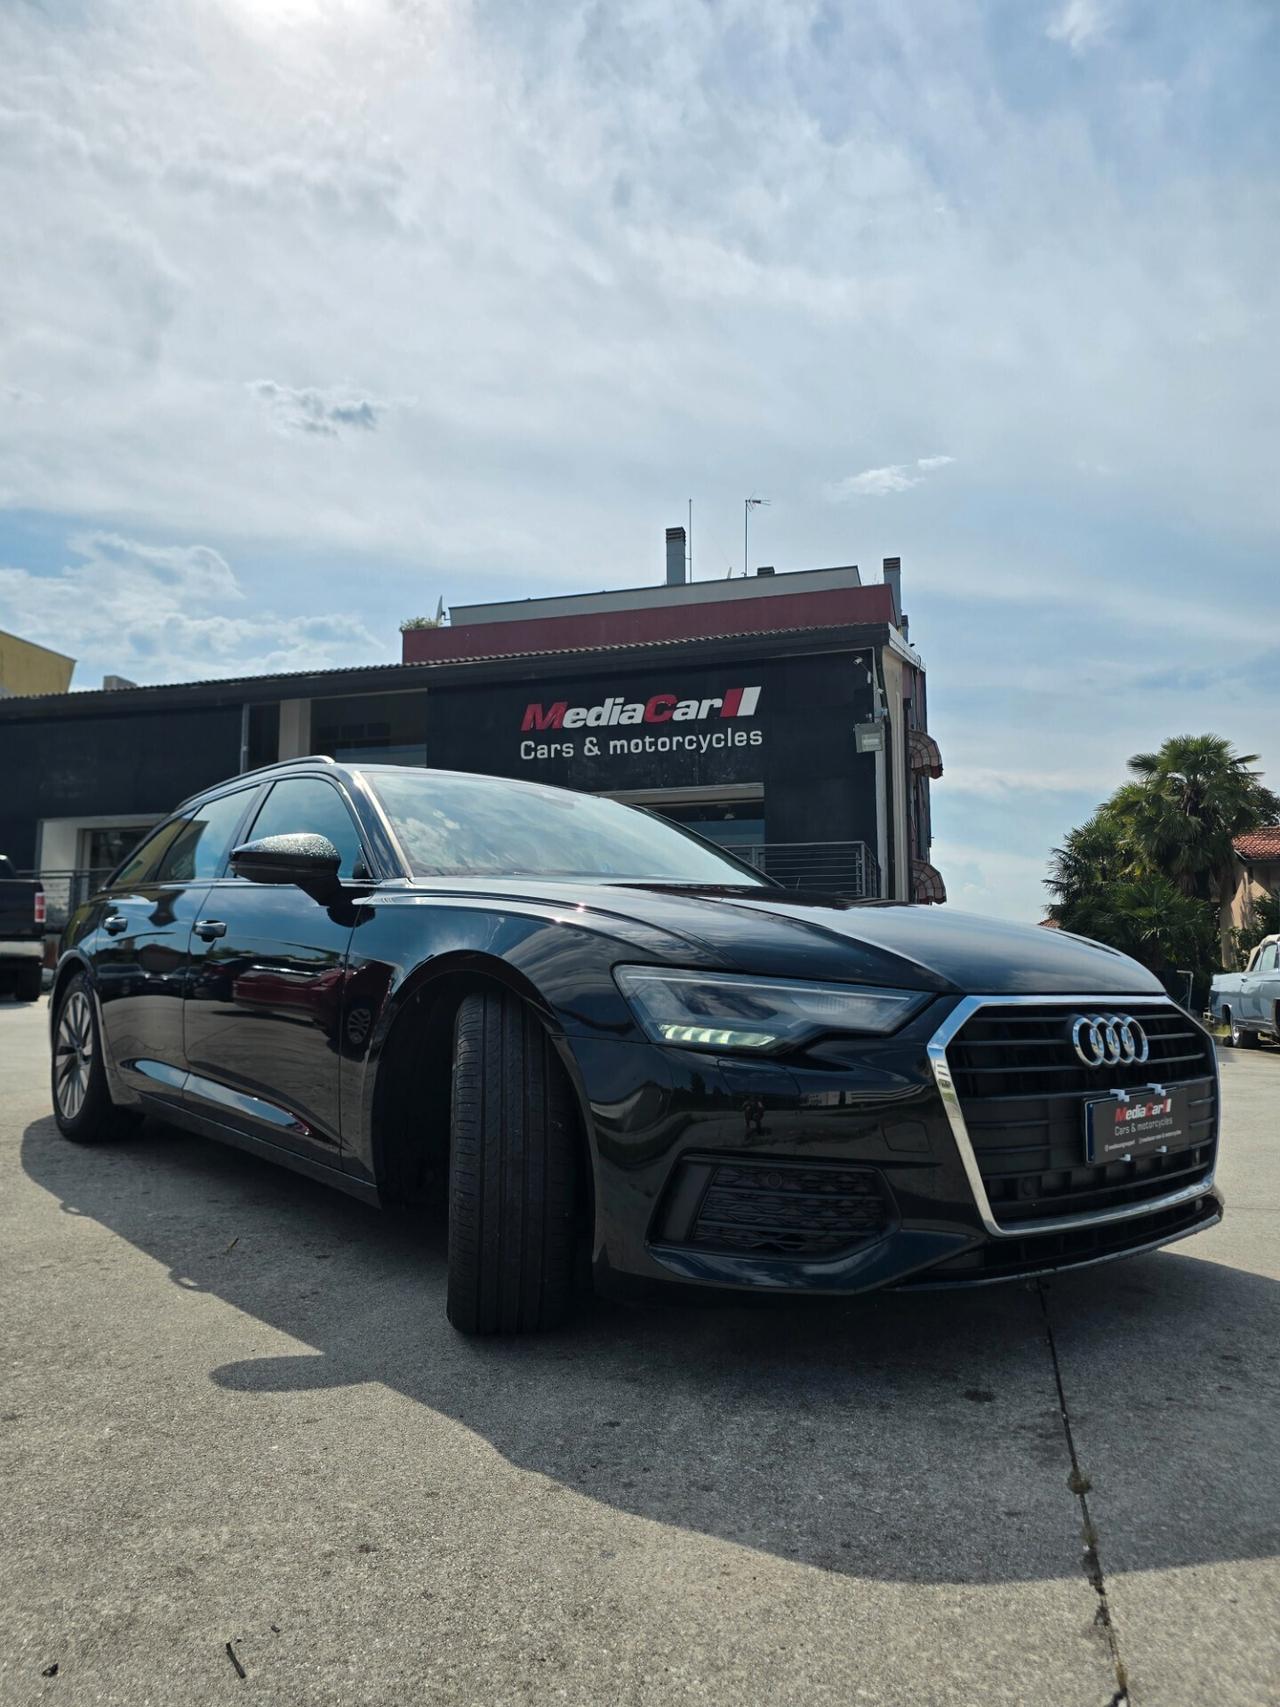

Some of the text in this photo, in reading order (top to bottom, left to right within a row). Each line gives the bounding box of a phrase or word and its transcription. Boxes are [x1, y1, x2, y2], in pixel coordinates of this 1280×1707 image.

[520, 693, 723, 731] MediaCar
[520, 727, 763, 760] Cars & motorcycles
[1115, 1102, 1164, 1121] MediaCar
[1115, 1125, 1130, 1136] Cars
[1131, 1123, 1136, 1133] &
